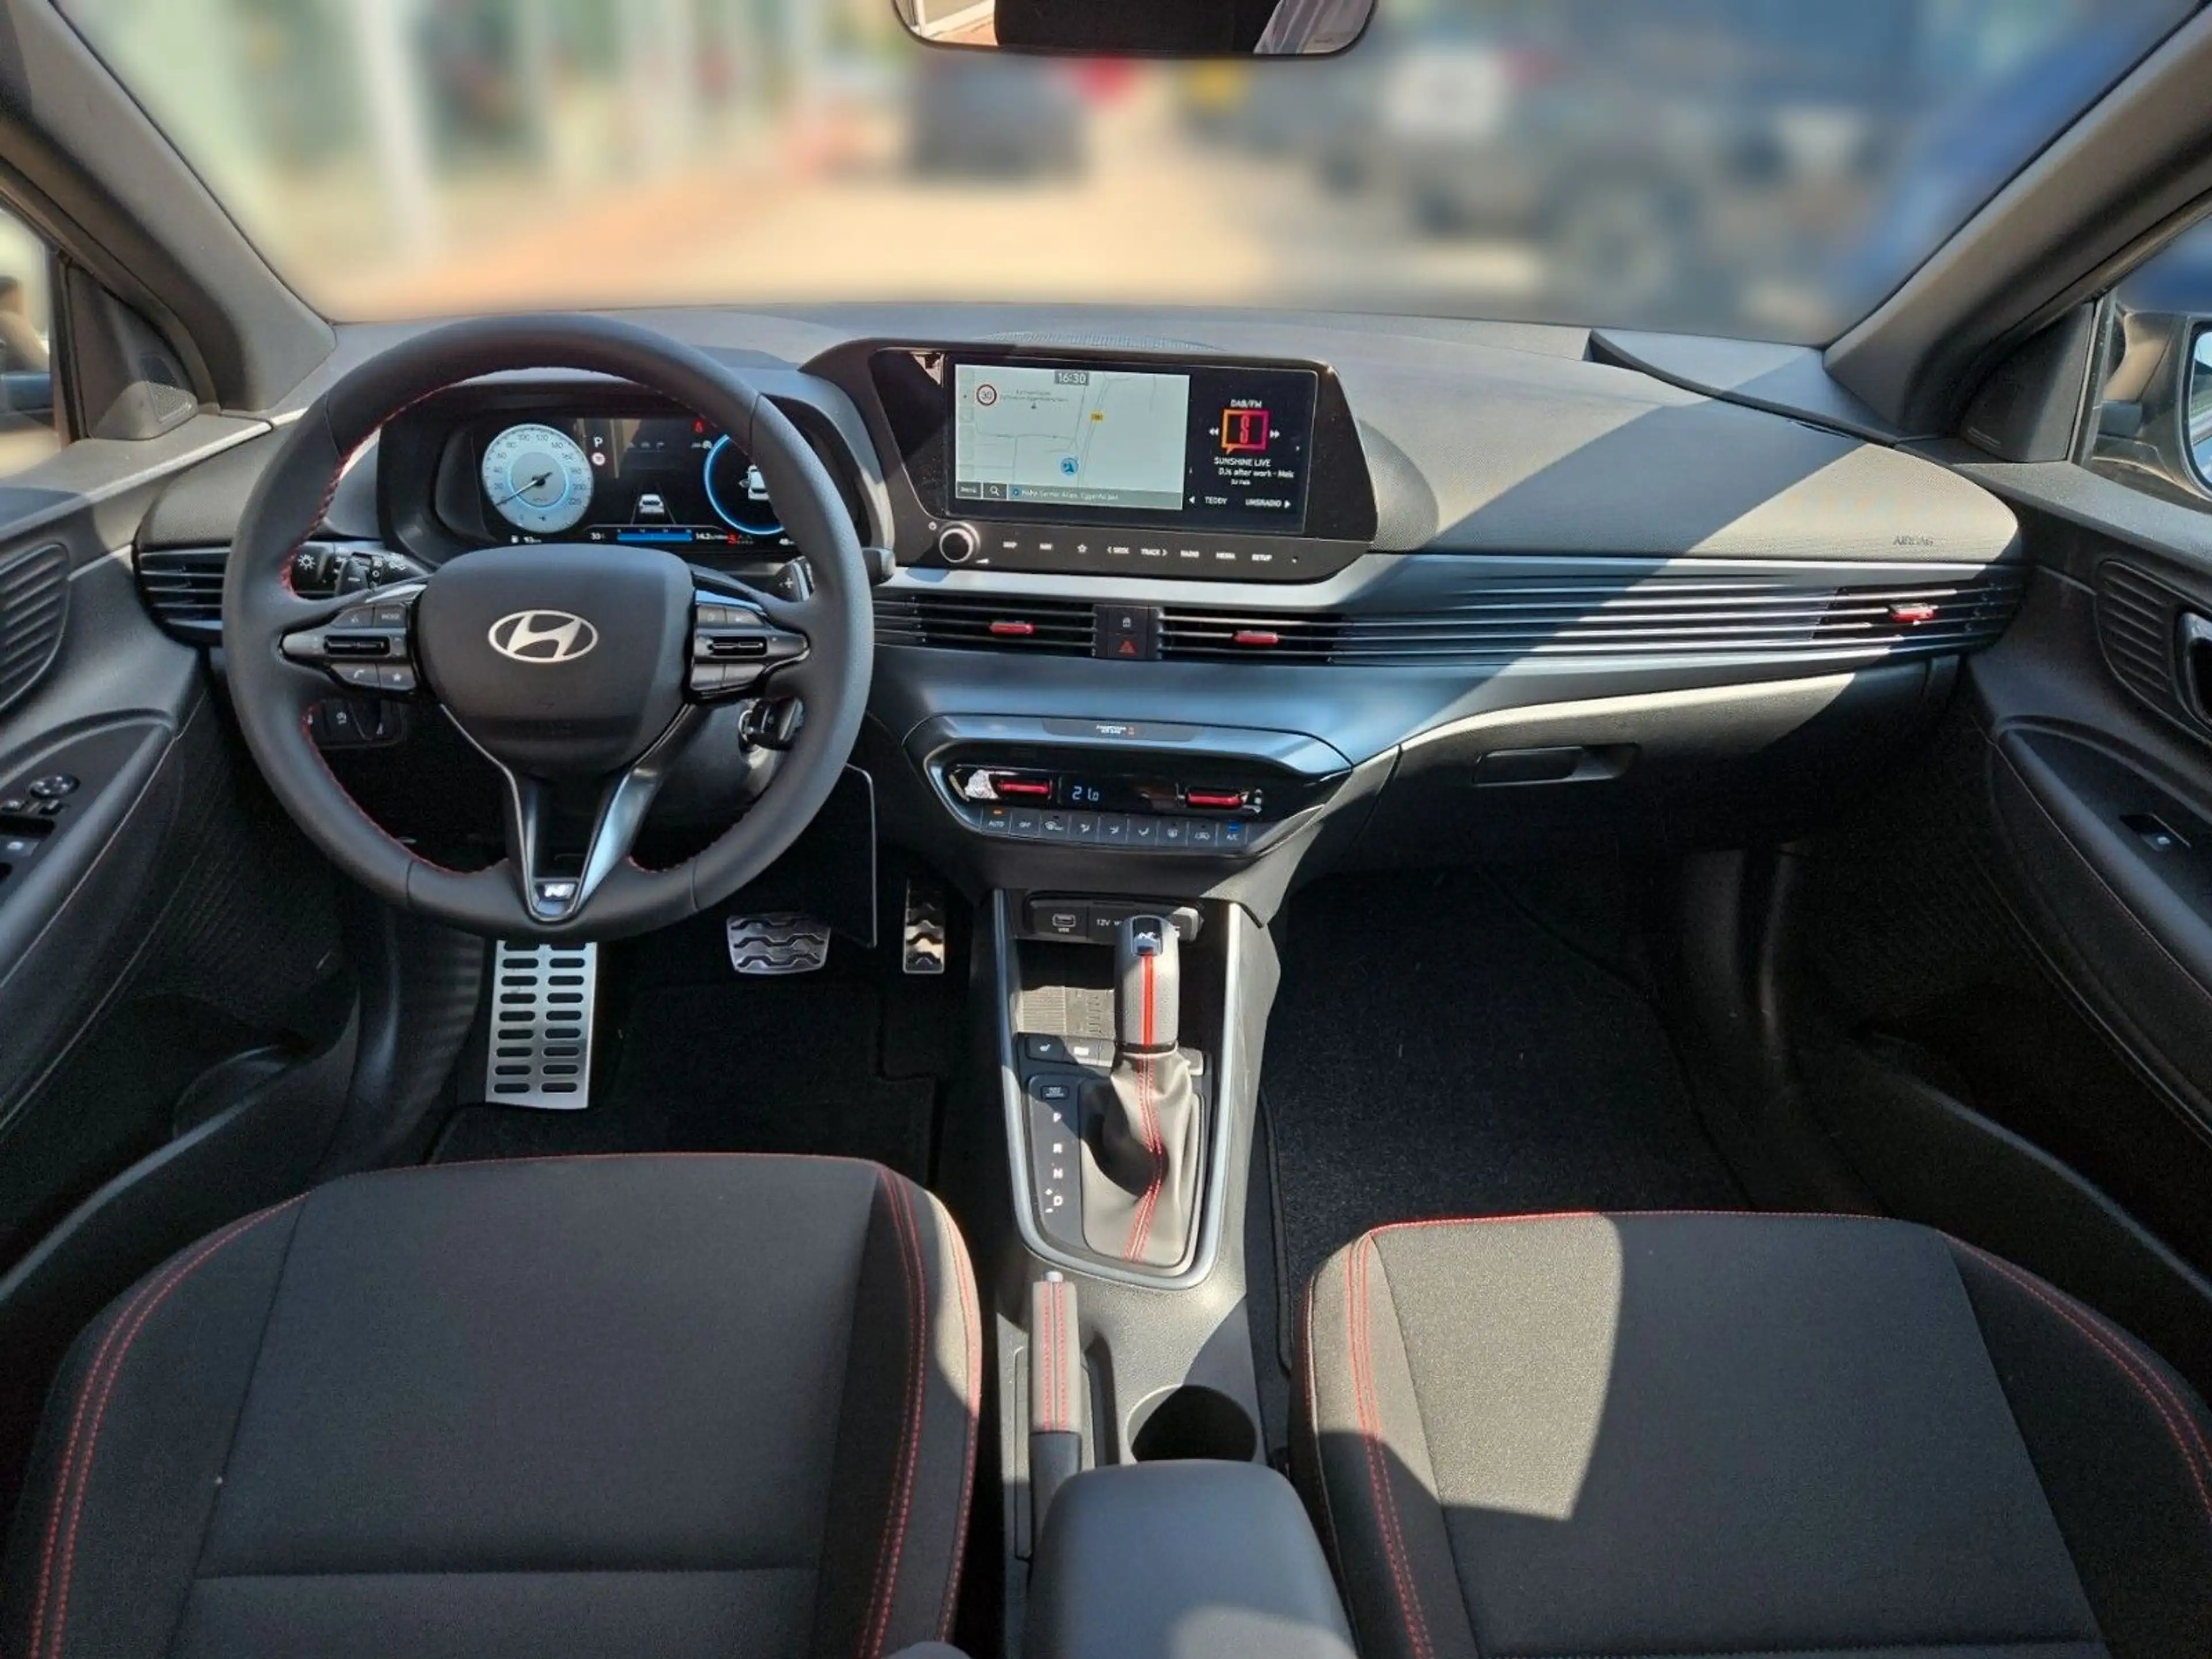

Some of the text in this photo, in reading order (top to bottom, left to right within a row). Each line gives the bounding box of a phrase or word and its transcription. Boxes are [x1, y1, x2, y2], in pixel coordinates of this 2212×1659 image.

[1058, 373, 1086, 384] 16:30
[1230, 399, 1263, 408] DAB/FM
[593, 436, 603, 448] P
[1214, 456, 1271, 467] SUNSHINE LIVE
[1205, 496, 1228, 505] TEDDY
[1141, 548, 1161, 556] TRACK
[1181, 550, 1200, 558] RADIO
[988, 820, 1006, 828] AUTO
[1097, 918, 1111, 926] 12V
[1053, 1112, 1063, 1123] P
[1053, 1143, 1063, 1154] R
[1053, 1168, 1063, 1179] N
[1053, 1195, 1063, 1206] D
